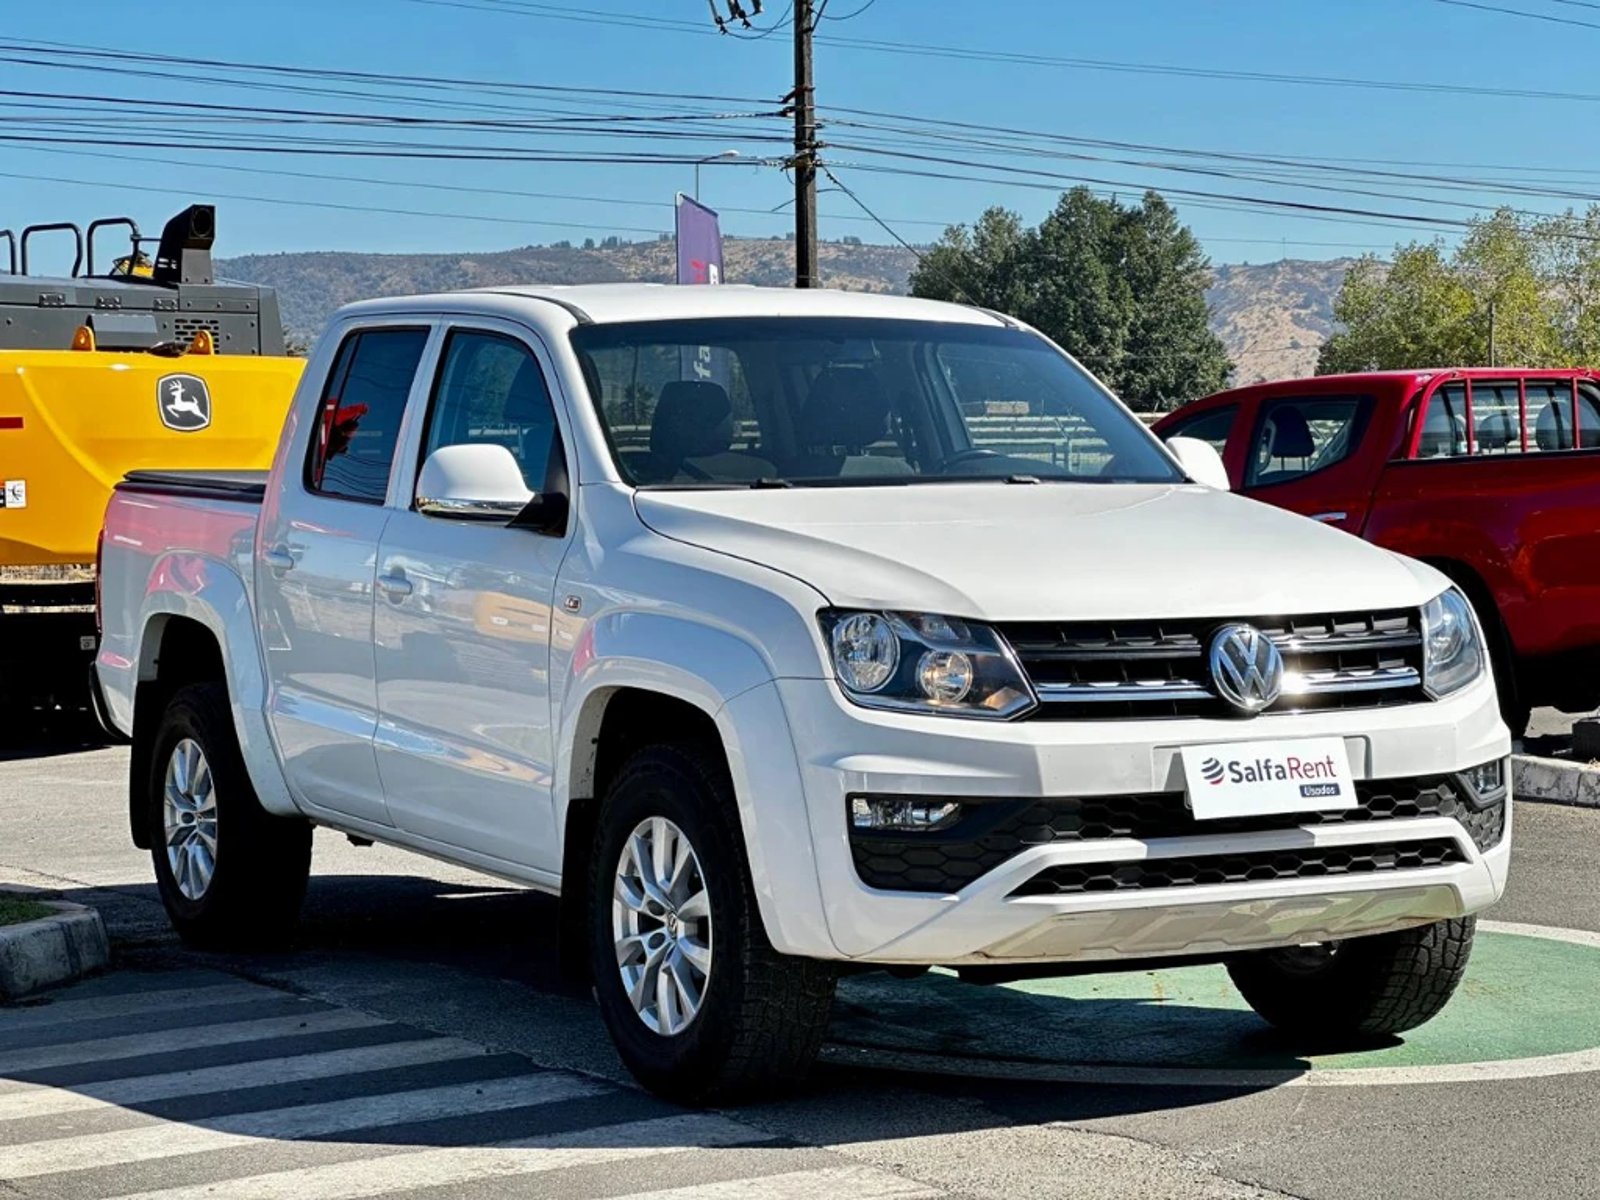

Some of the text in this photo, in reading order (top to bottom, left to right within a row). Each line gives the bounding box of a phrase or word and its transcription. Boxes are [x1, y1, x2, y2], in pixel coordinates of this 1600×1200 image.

[693, 345, 711, 380] fa
[1228, 754, 1337, 783] SalfaRent
[1303, 785, 1336, 796] Usados
